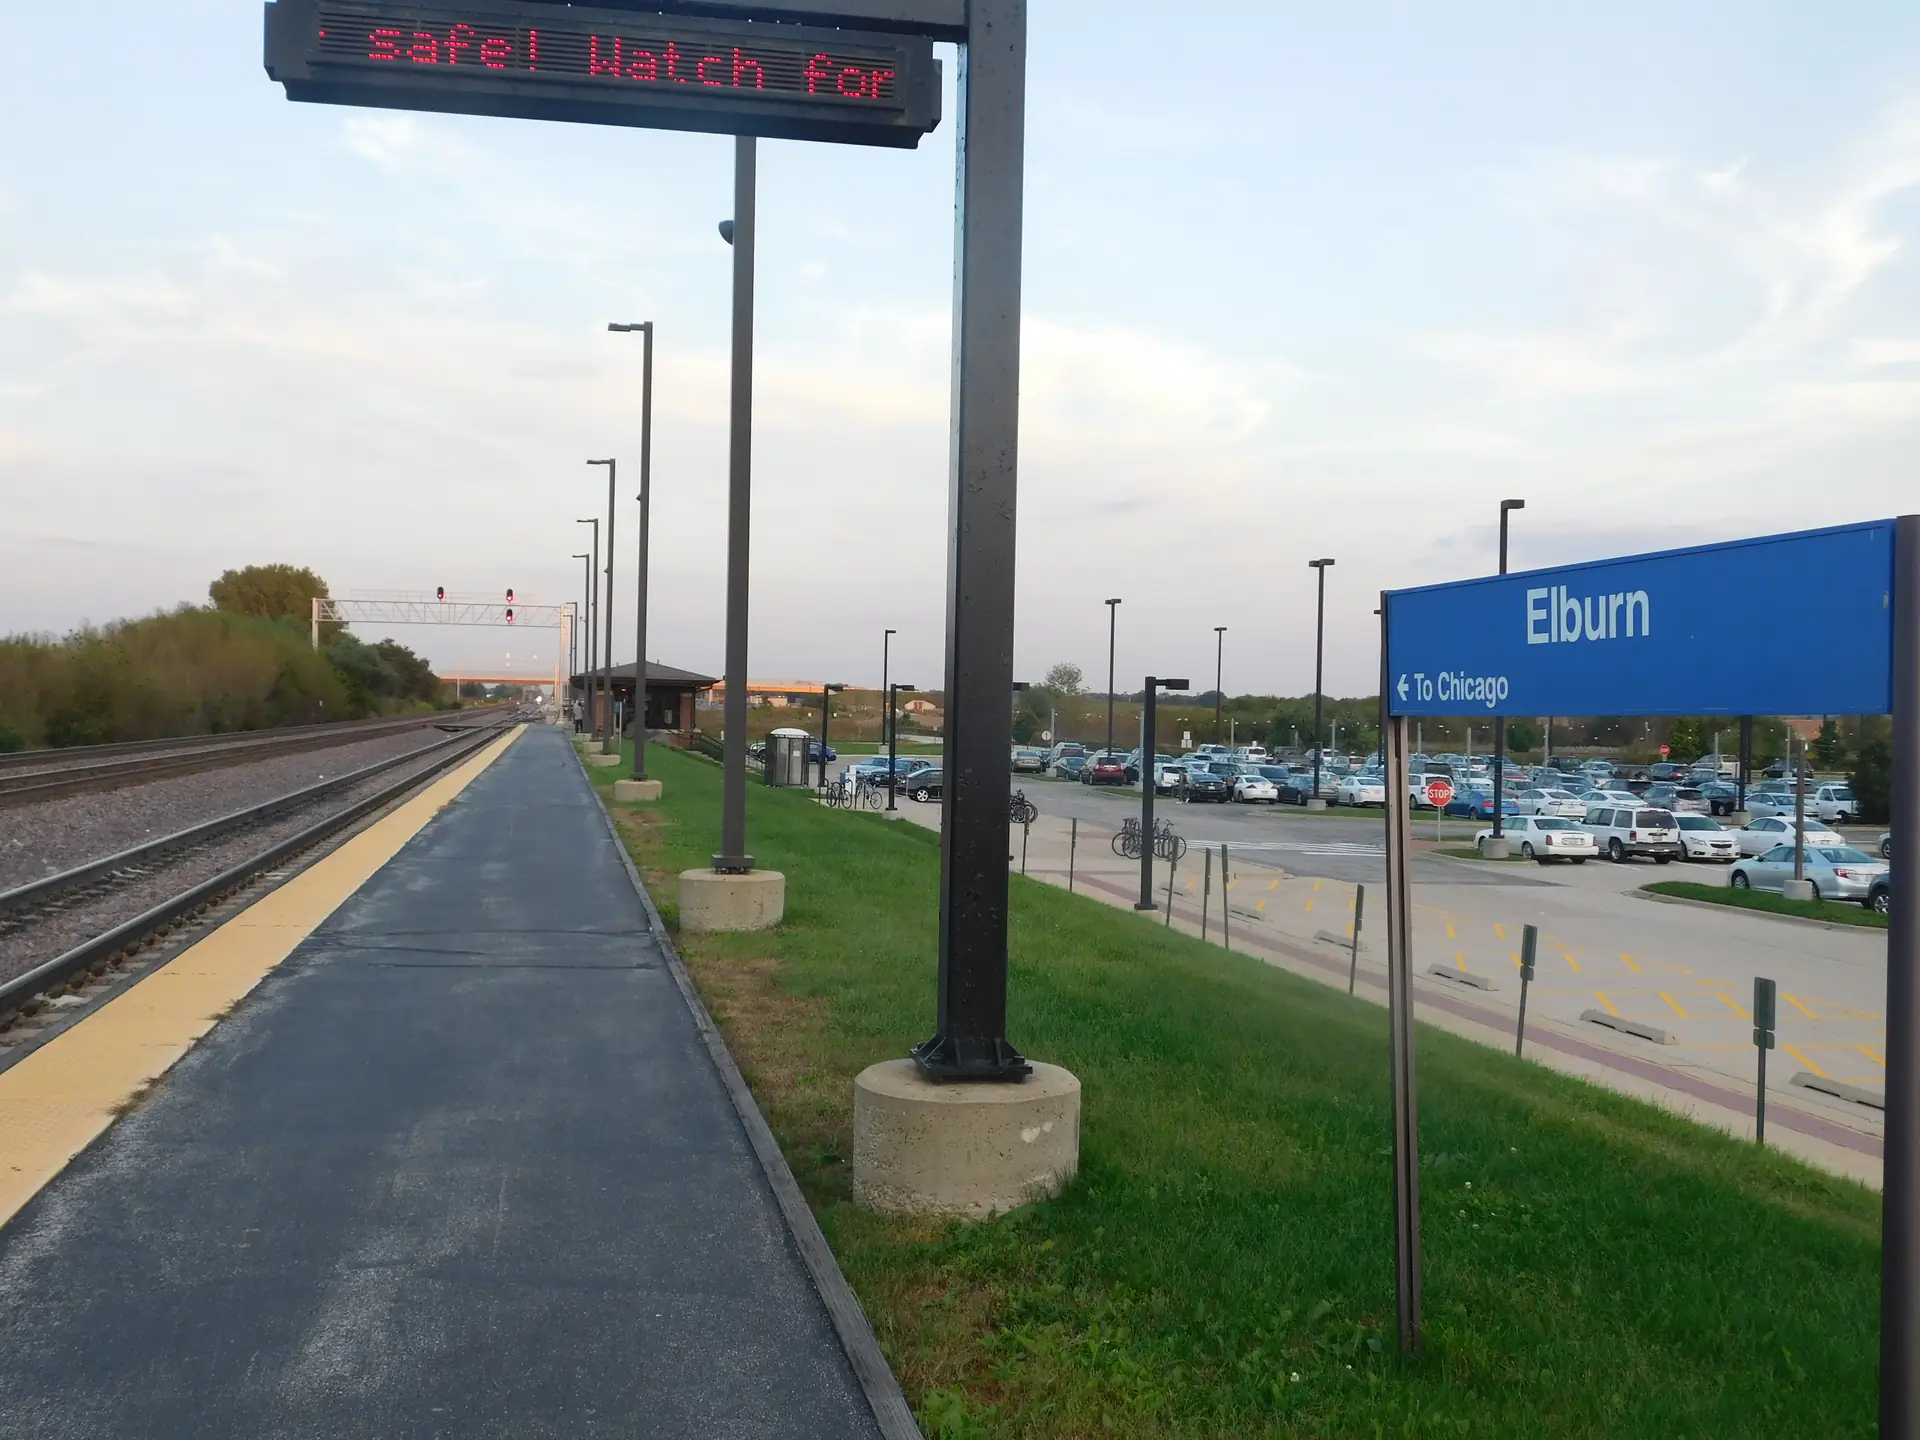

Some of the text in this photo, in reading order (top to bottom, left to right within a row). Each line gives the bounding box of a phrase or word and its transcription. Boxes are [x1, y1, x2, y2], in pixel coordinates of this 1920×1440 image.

[368, 24, 896, 99] safe! Watch for
[1526, 584, 1650, 645] Elburn
[1413, 671, 1509, 709] To Chicago
[1428, 788, 1450, 799] STOP
